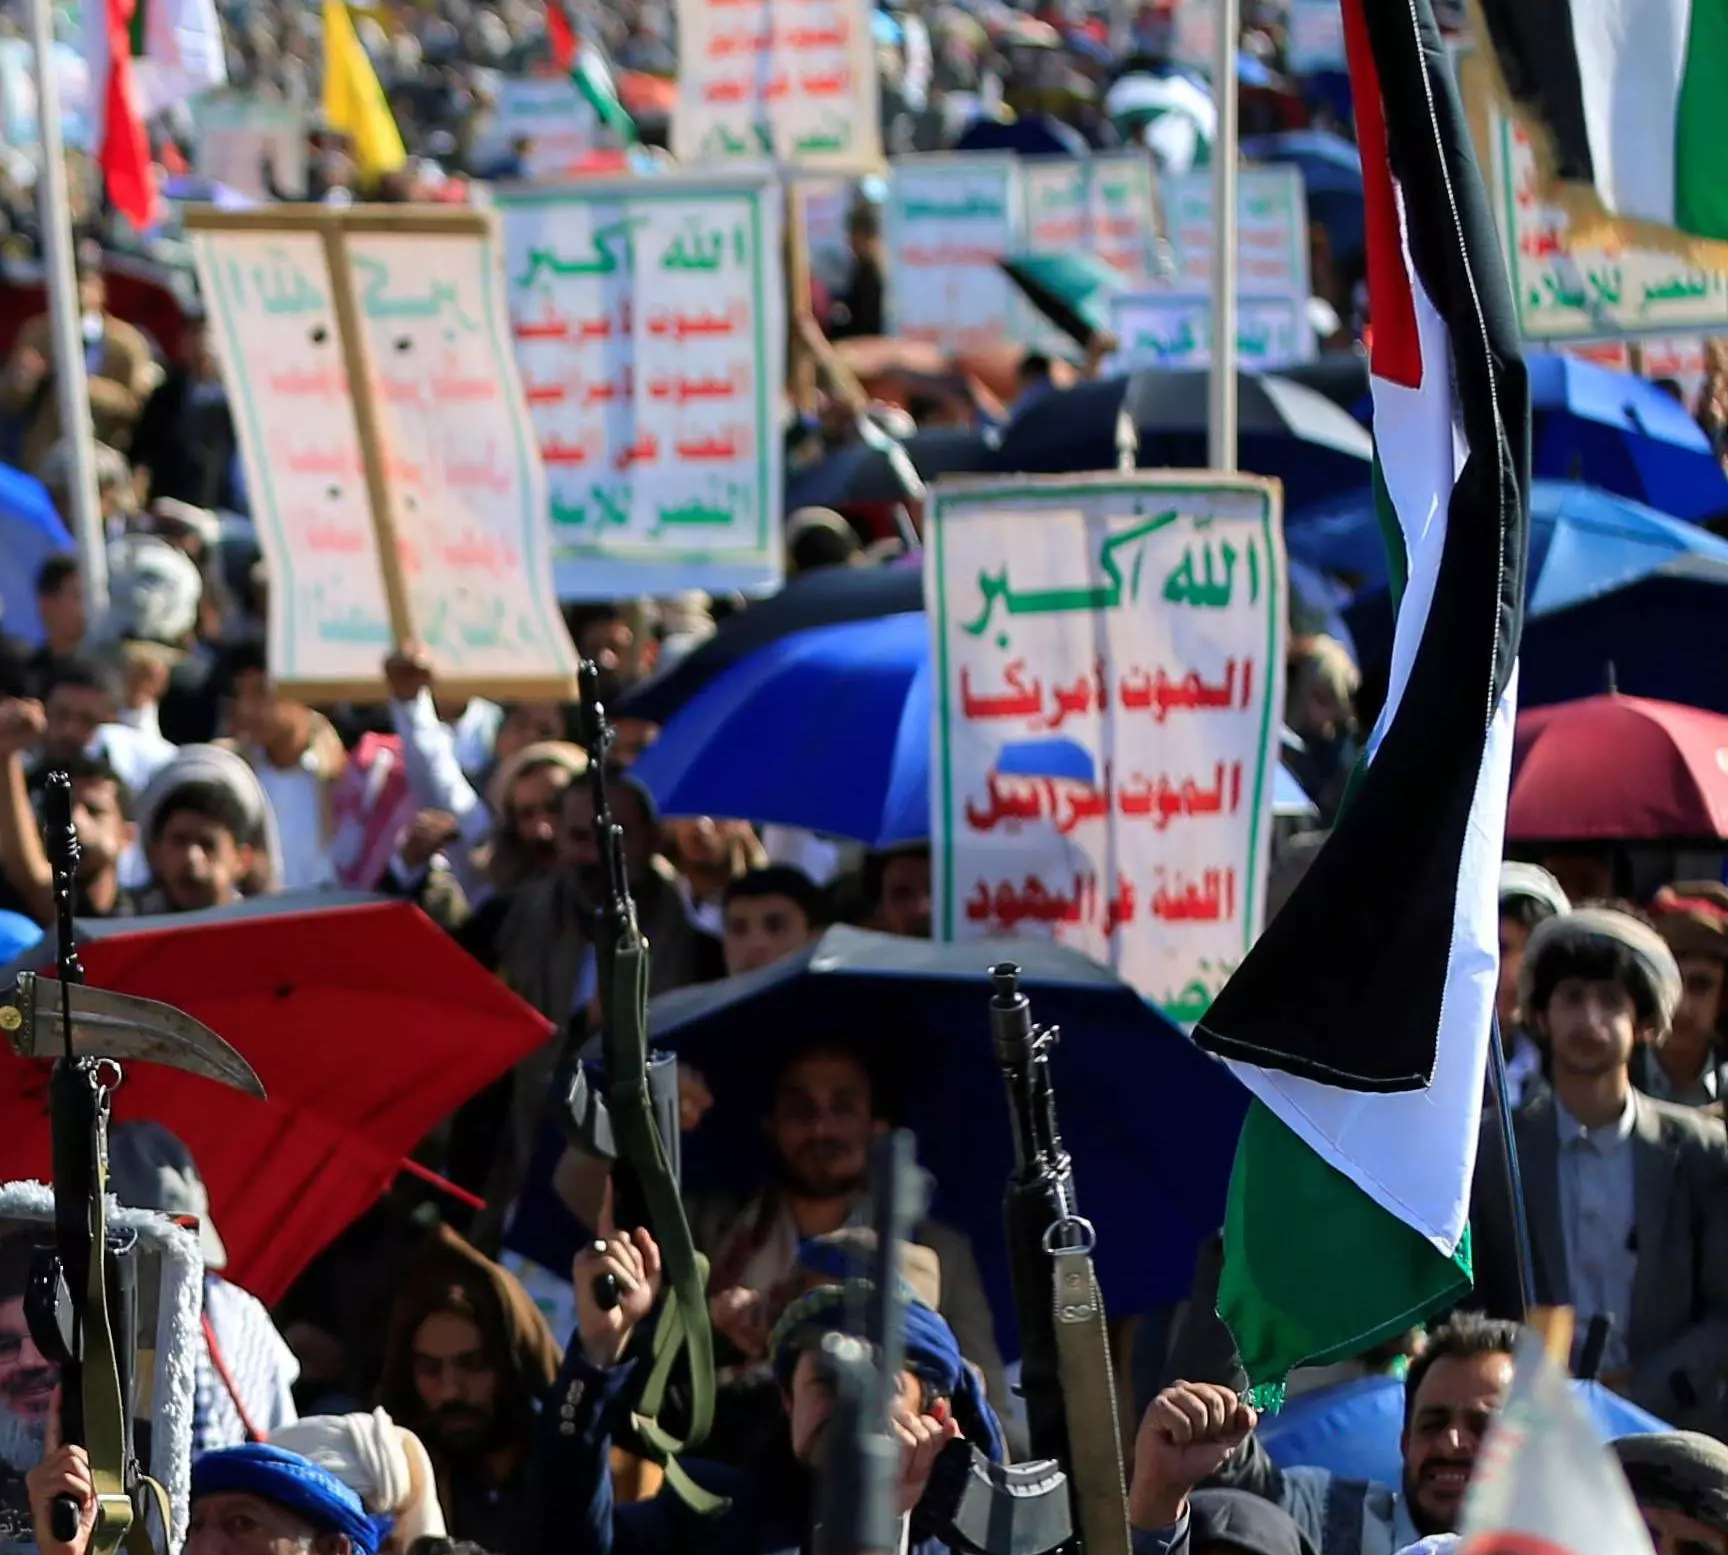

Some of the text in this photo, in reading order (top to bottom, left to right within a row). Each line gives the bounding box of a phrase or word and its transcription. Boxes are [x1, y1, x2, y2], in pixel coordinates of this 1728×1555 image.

[960, 500, 1259, 649] الله أكبر
[1118, 656, 1254, 725] الموت
